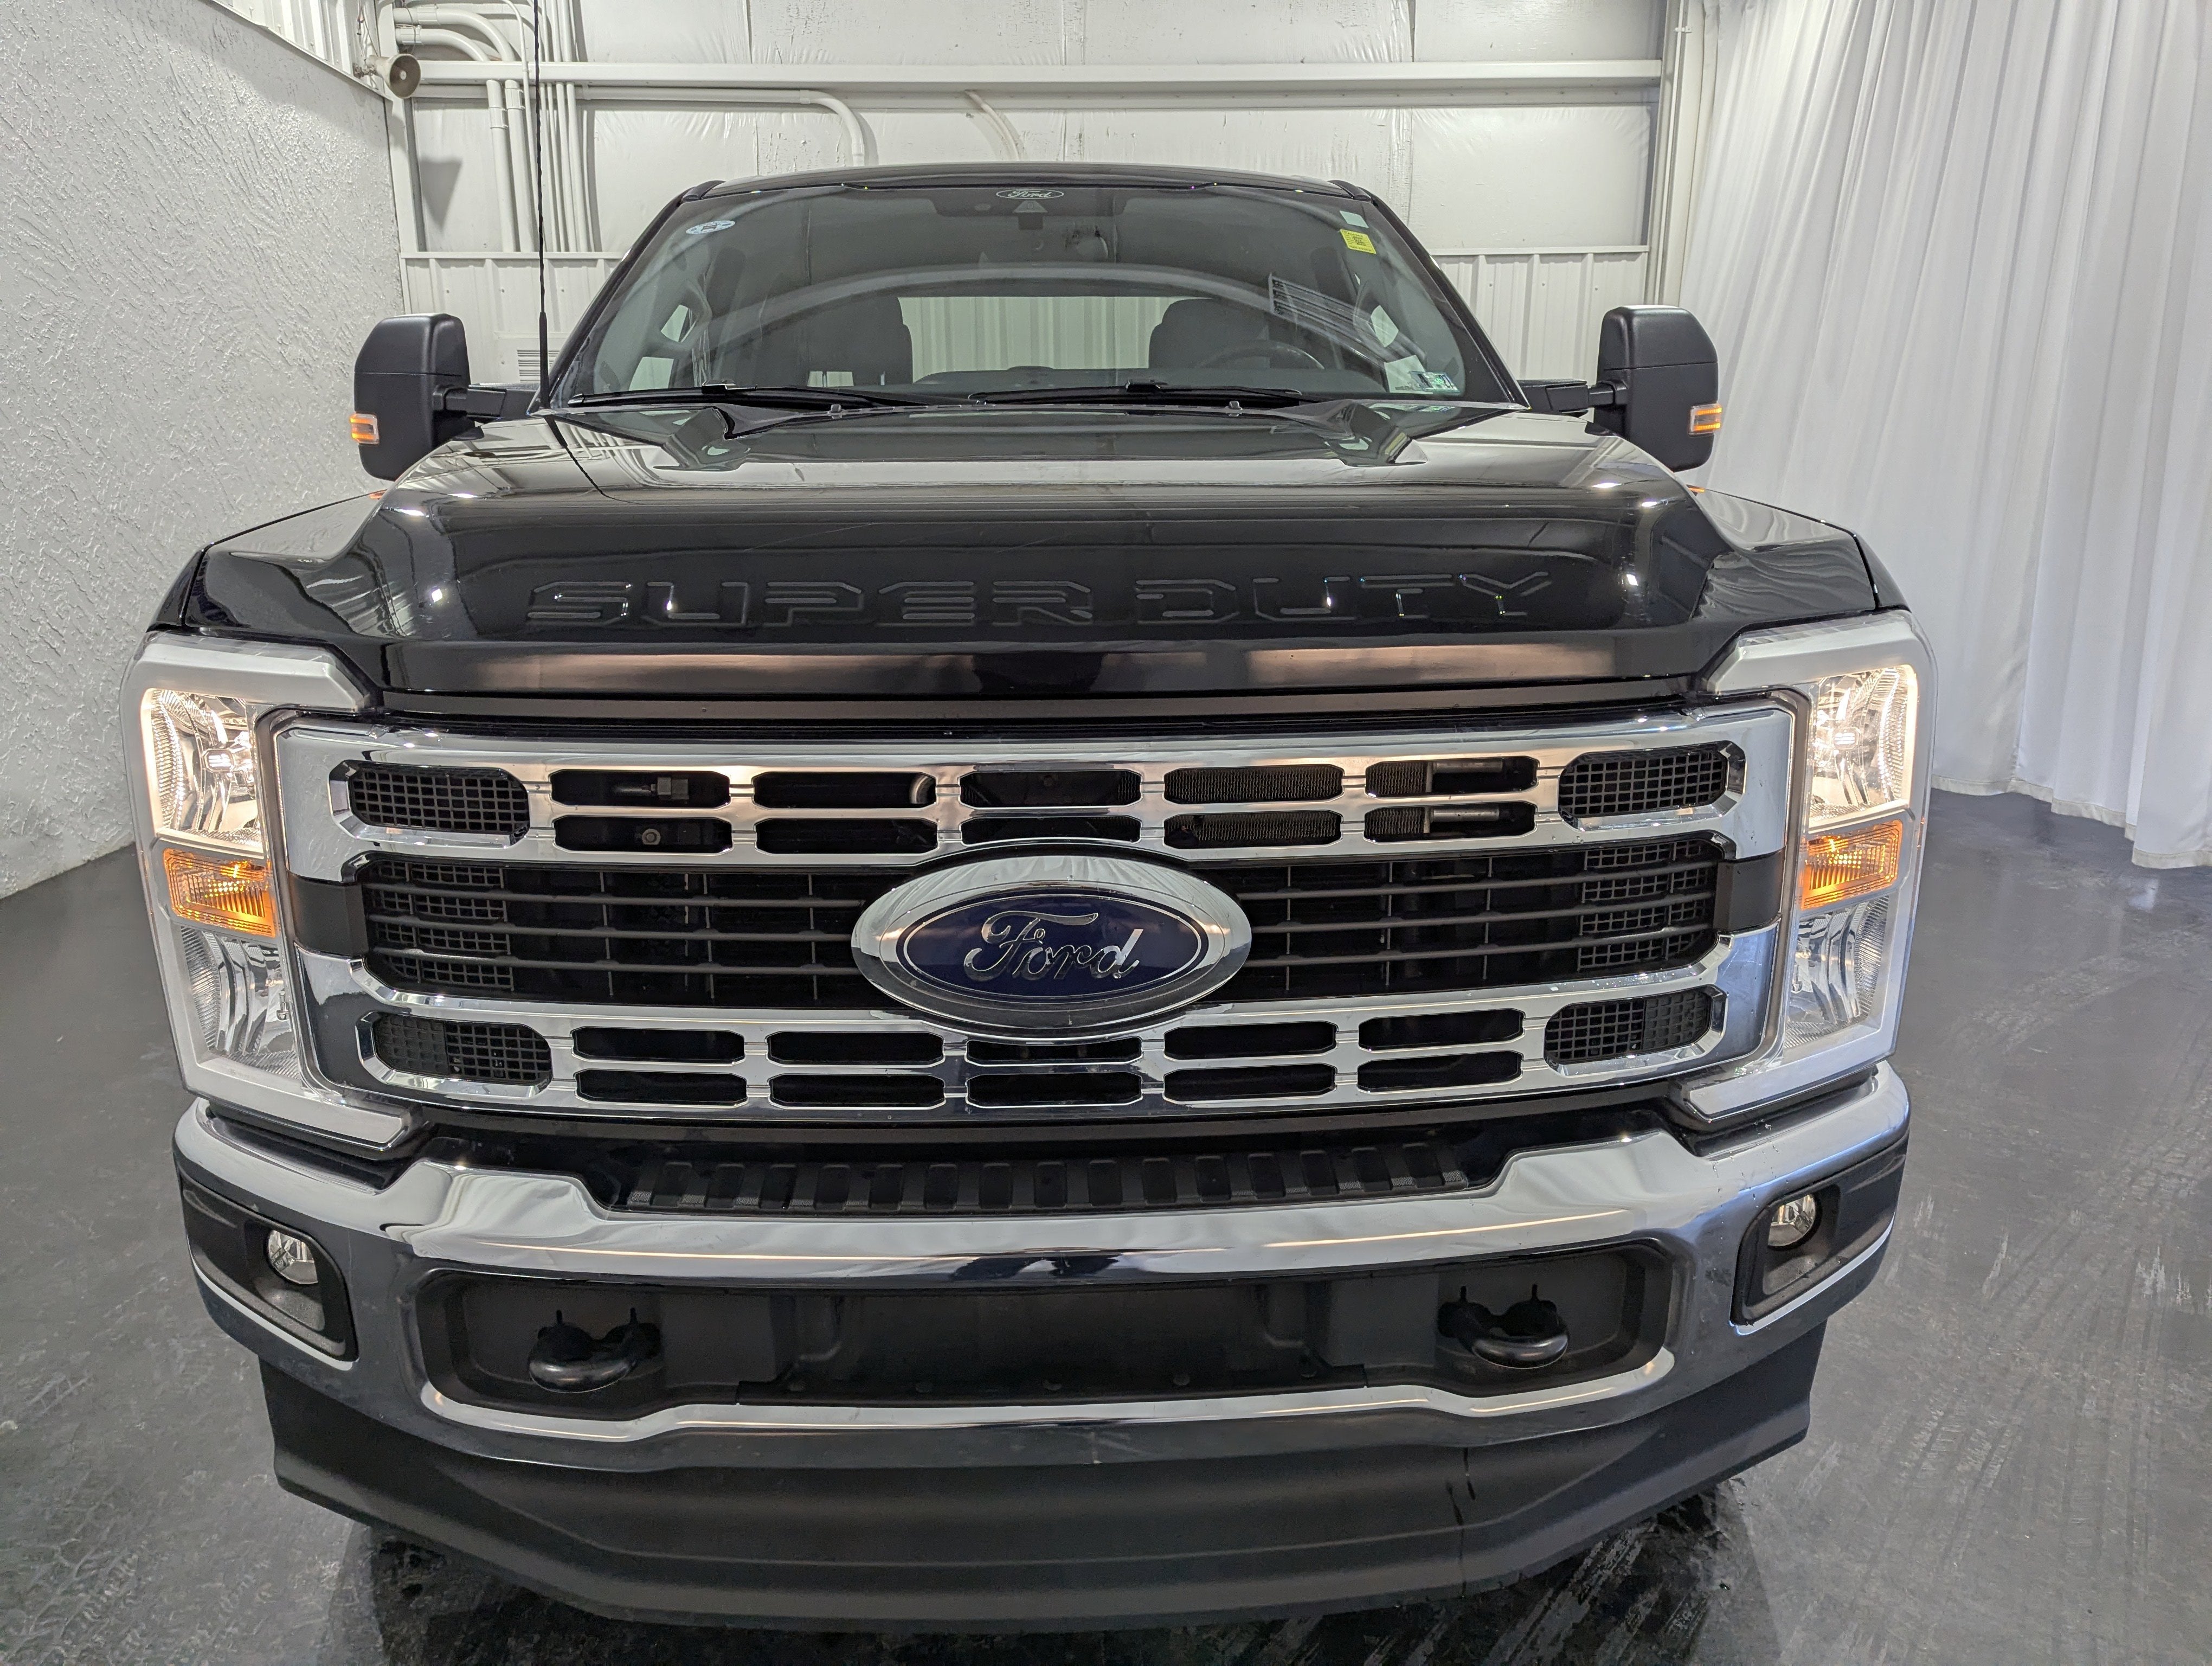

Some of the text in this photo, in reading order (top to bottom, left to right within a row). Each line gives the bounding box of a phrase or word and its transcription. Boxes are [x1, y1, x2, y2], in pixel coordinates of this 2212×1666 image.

[526, 571, 1553, 627] SUPER DUTY
[963, 910, 1144, 981] Ford
